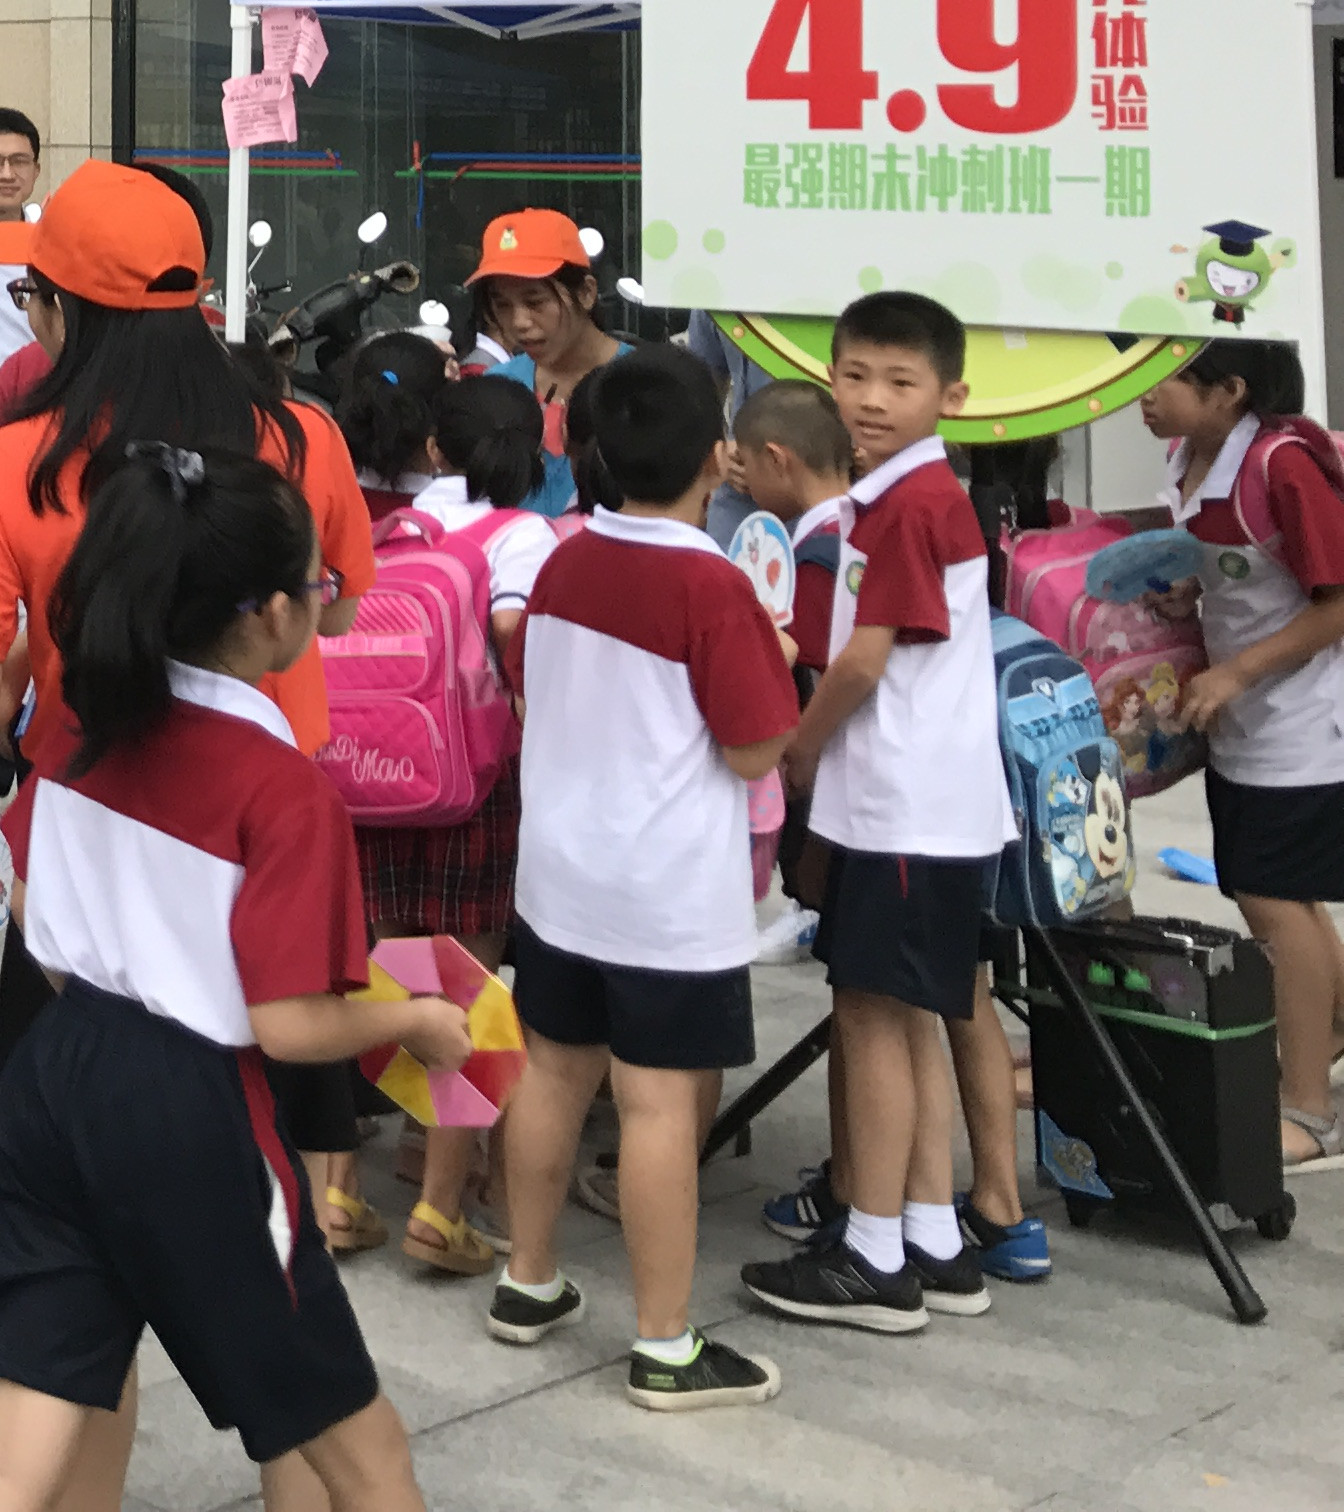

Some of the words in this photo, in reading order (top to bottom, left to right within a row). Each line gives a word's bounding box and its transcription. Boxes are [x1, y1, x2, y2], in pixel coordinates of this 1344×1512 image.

[743, 142, 1151, 218] 最强期末冲刺班一期
